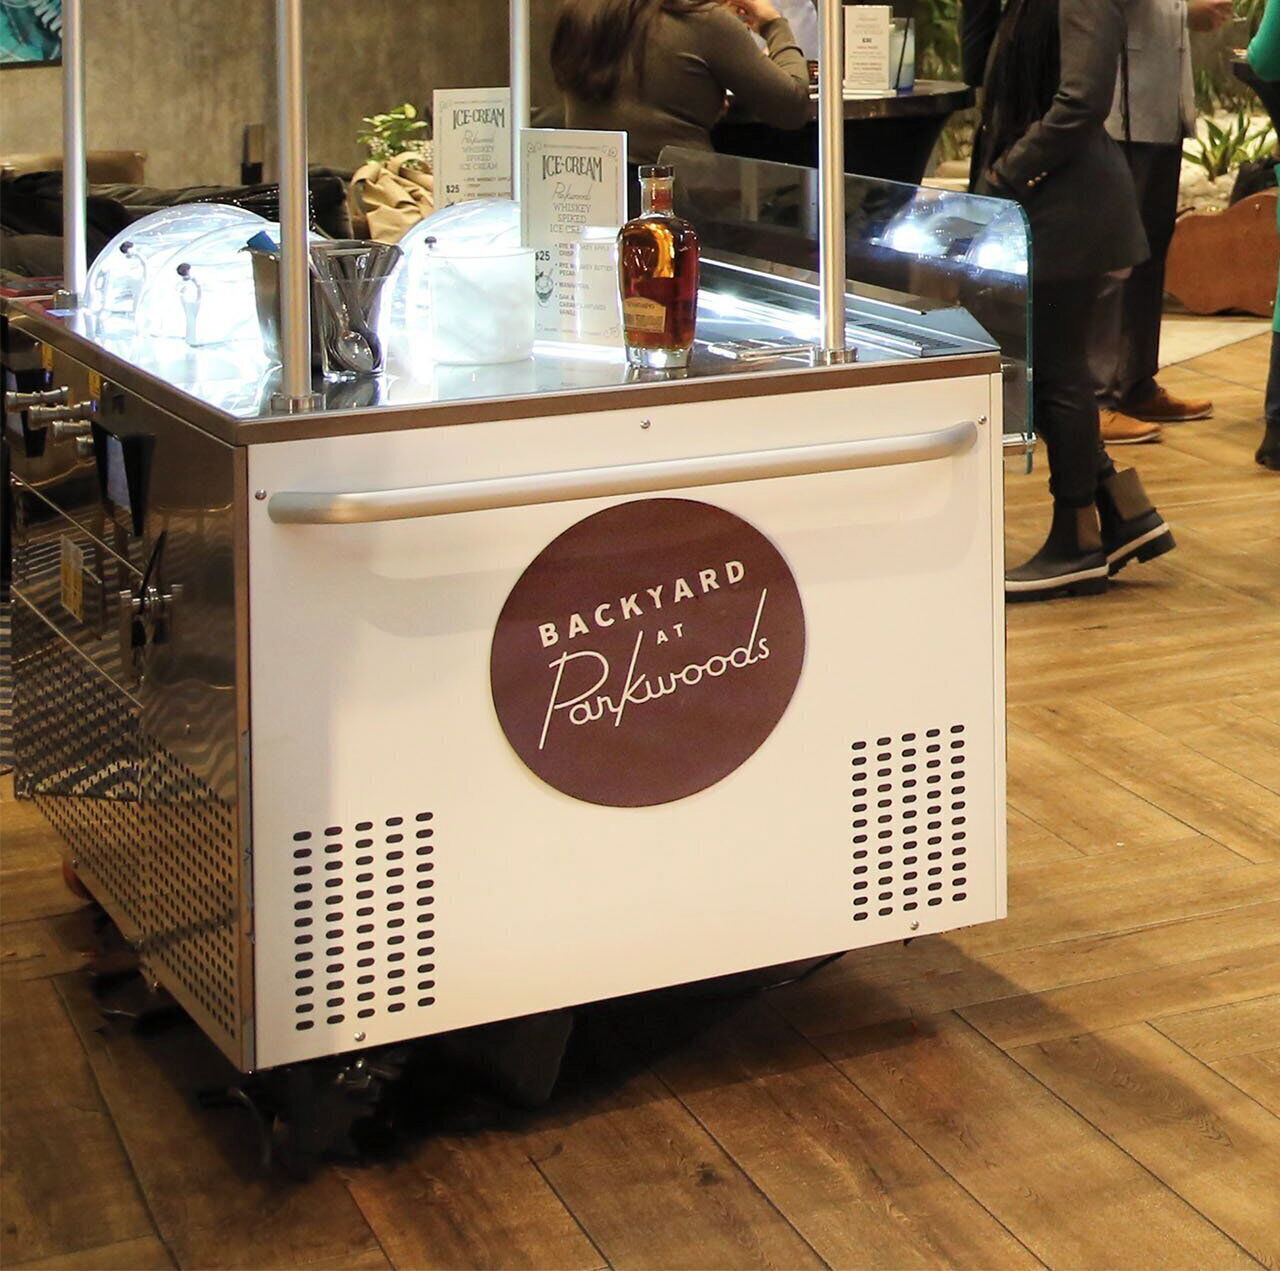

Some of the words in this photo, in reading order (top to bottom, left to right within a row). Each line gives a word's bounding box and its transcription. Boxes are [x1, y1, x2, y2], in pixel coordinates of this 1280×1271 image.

[453, 107, 505, 130] ICE-CREAM
[542, 155, 602, 183] ICE-CREAM
[446, 184, 460, 193] $25
[553, 202, 592, 213] WHISKEY
[550, 224, 563, 232] ICE
[557, 214, 587, 223] SPIKED
[537, 559, 746, 648] BACKYARD
[656, 623, 685, 644] AT
[538, 588, 771, 750] Parkwoods
